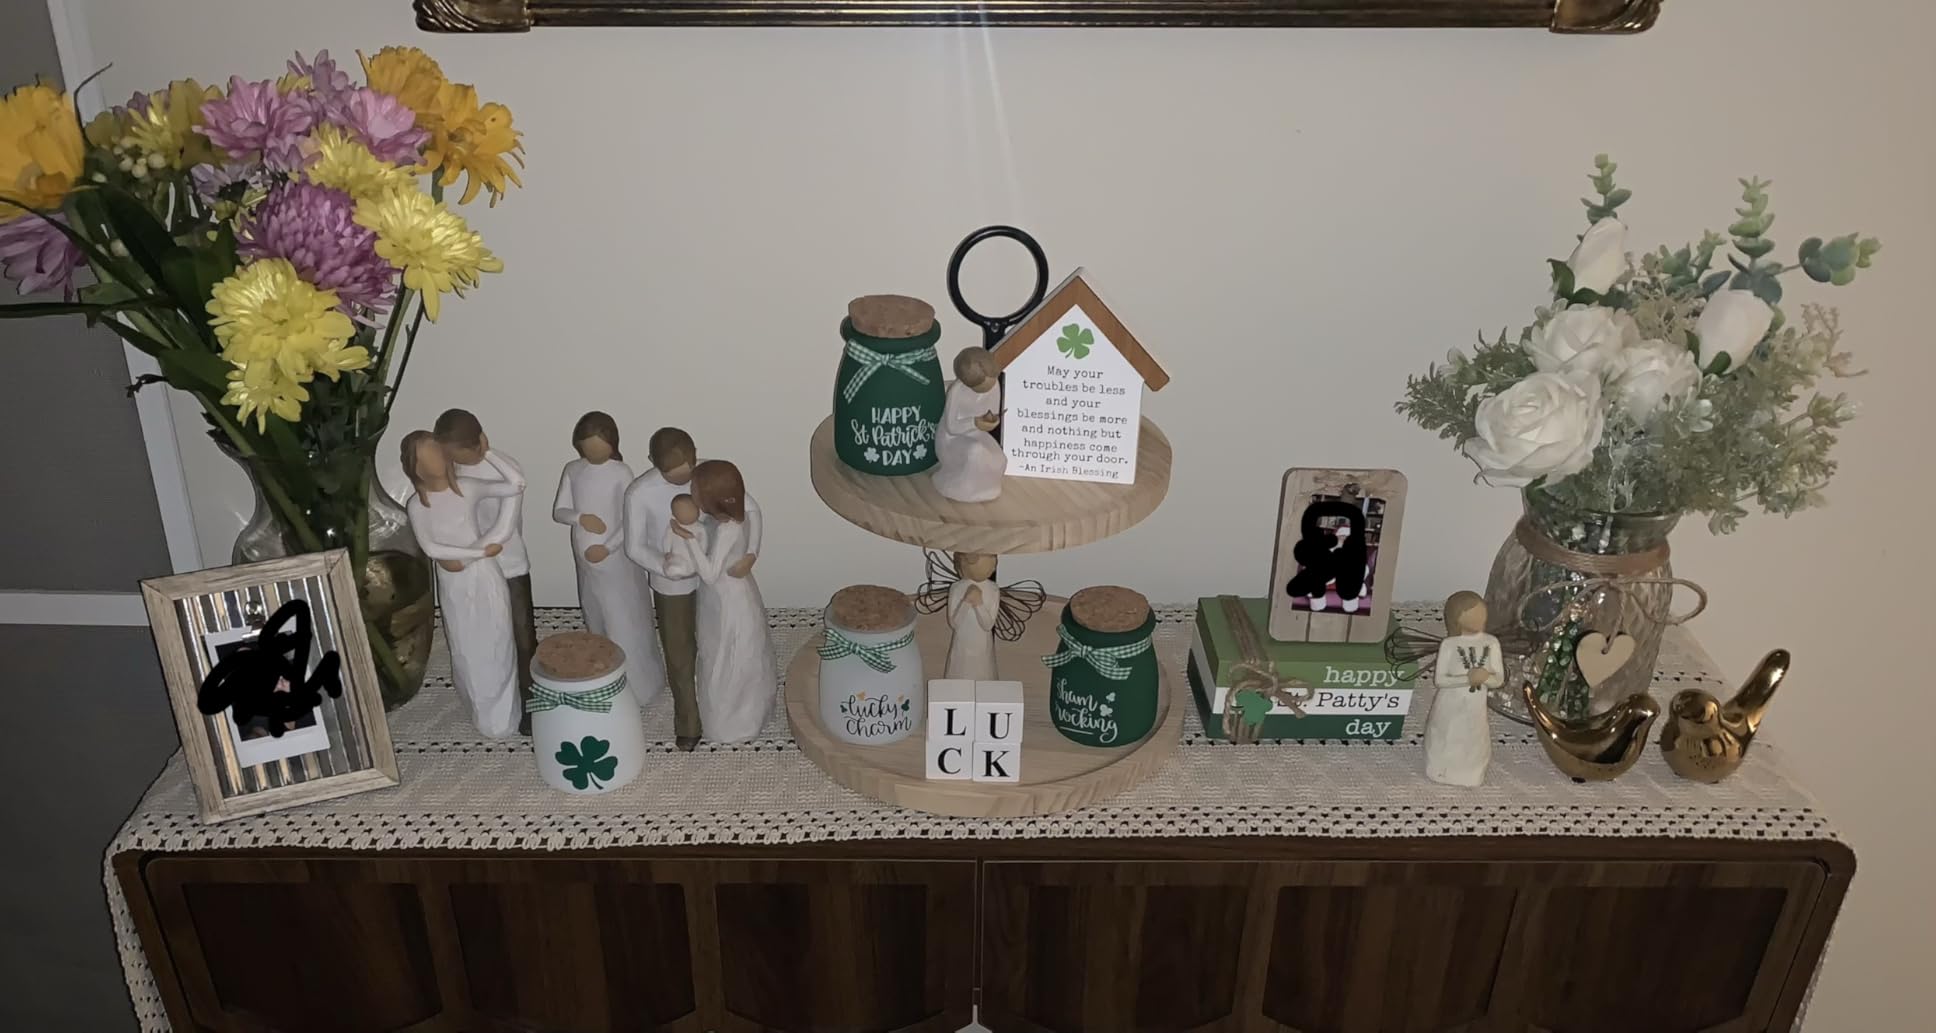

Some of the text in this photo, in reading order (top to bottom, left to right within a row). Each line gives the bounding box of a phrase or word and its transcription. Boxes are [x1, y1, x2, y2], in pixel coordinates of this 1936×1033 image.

[1047, 365, 1104, 380] May your
[1023, 380, 1126, 395] troubles be less
[1045, 396, 1102, 409] and your
[871, 405, 921, 424] HAPPY
[1017, 408, 1128, 424] blessings be more
[851, 418, 870, 445] St
[1021, 424, 1122, 439] and nothing but
[1024, 438, 1118, 453] happiness come
[882, 449, 912, 466] DAY
[1011, 448, 1128, 464] through your door.
[1019, 464, 1119, 479] -An Irish Blessing
[1323, 666, 1405, 687] happy
[841, 694, 898, 720] lucky
[1315, 692, 1400, 711] Patty's
[843, 716, 912, 738] charm
[1345, 719, 1392, 737] day
